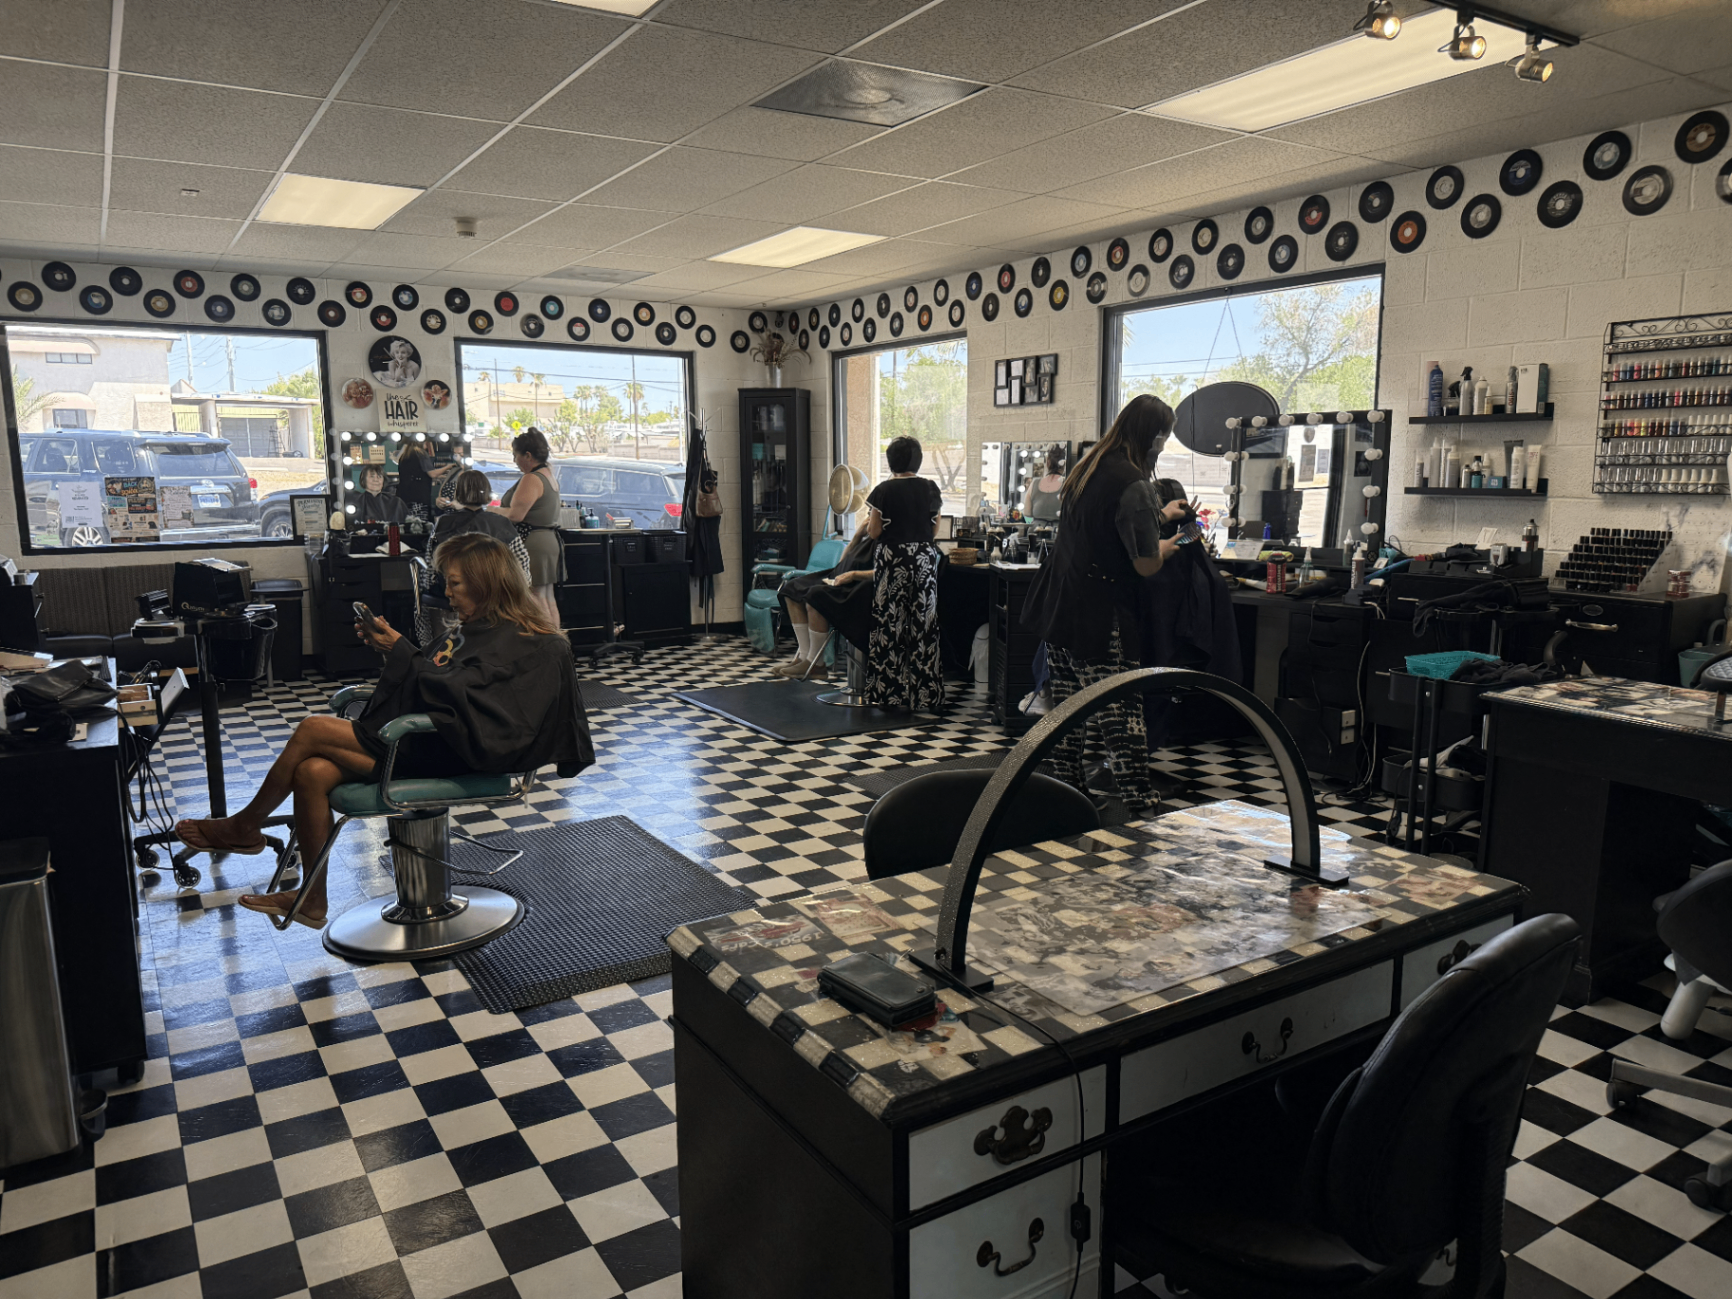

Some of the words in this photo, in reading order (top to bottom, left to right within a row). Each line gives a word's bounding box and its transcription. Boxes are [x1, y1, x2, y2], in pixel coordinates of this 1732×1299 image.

[386, 393, 400, 401] the
[384, 401, 419, 419] HAIR
[764, 931, 822, 948] 1950's
